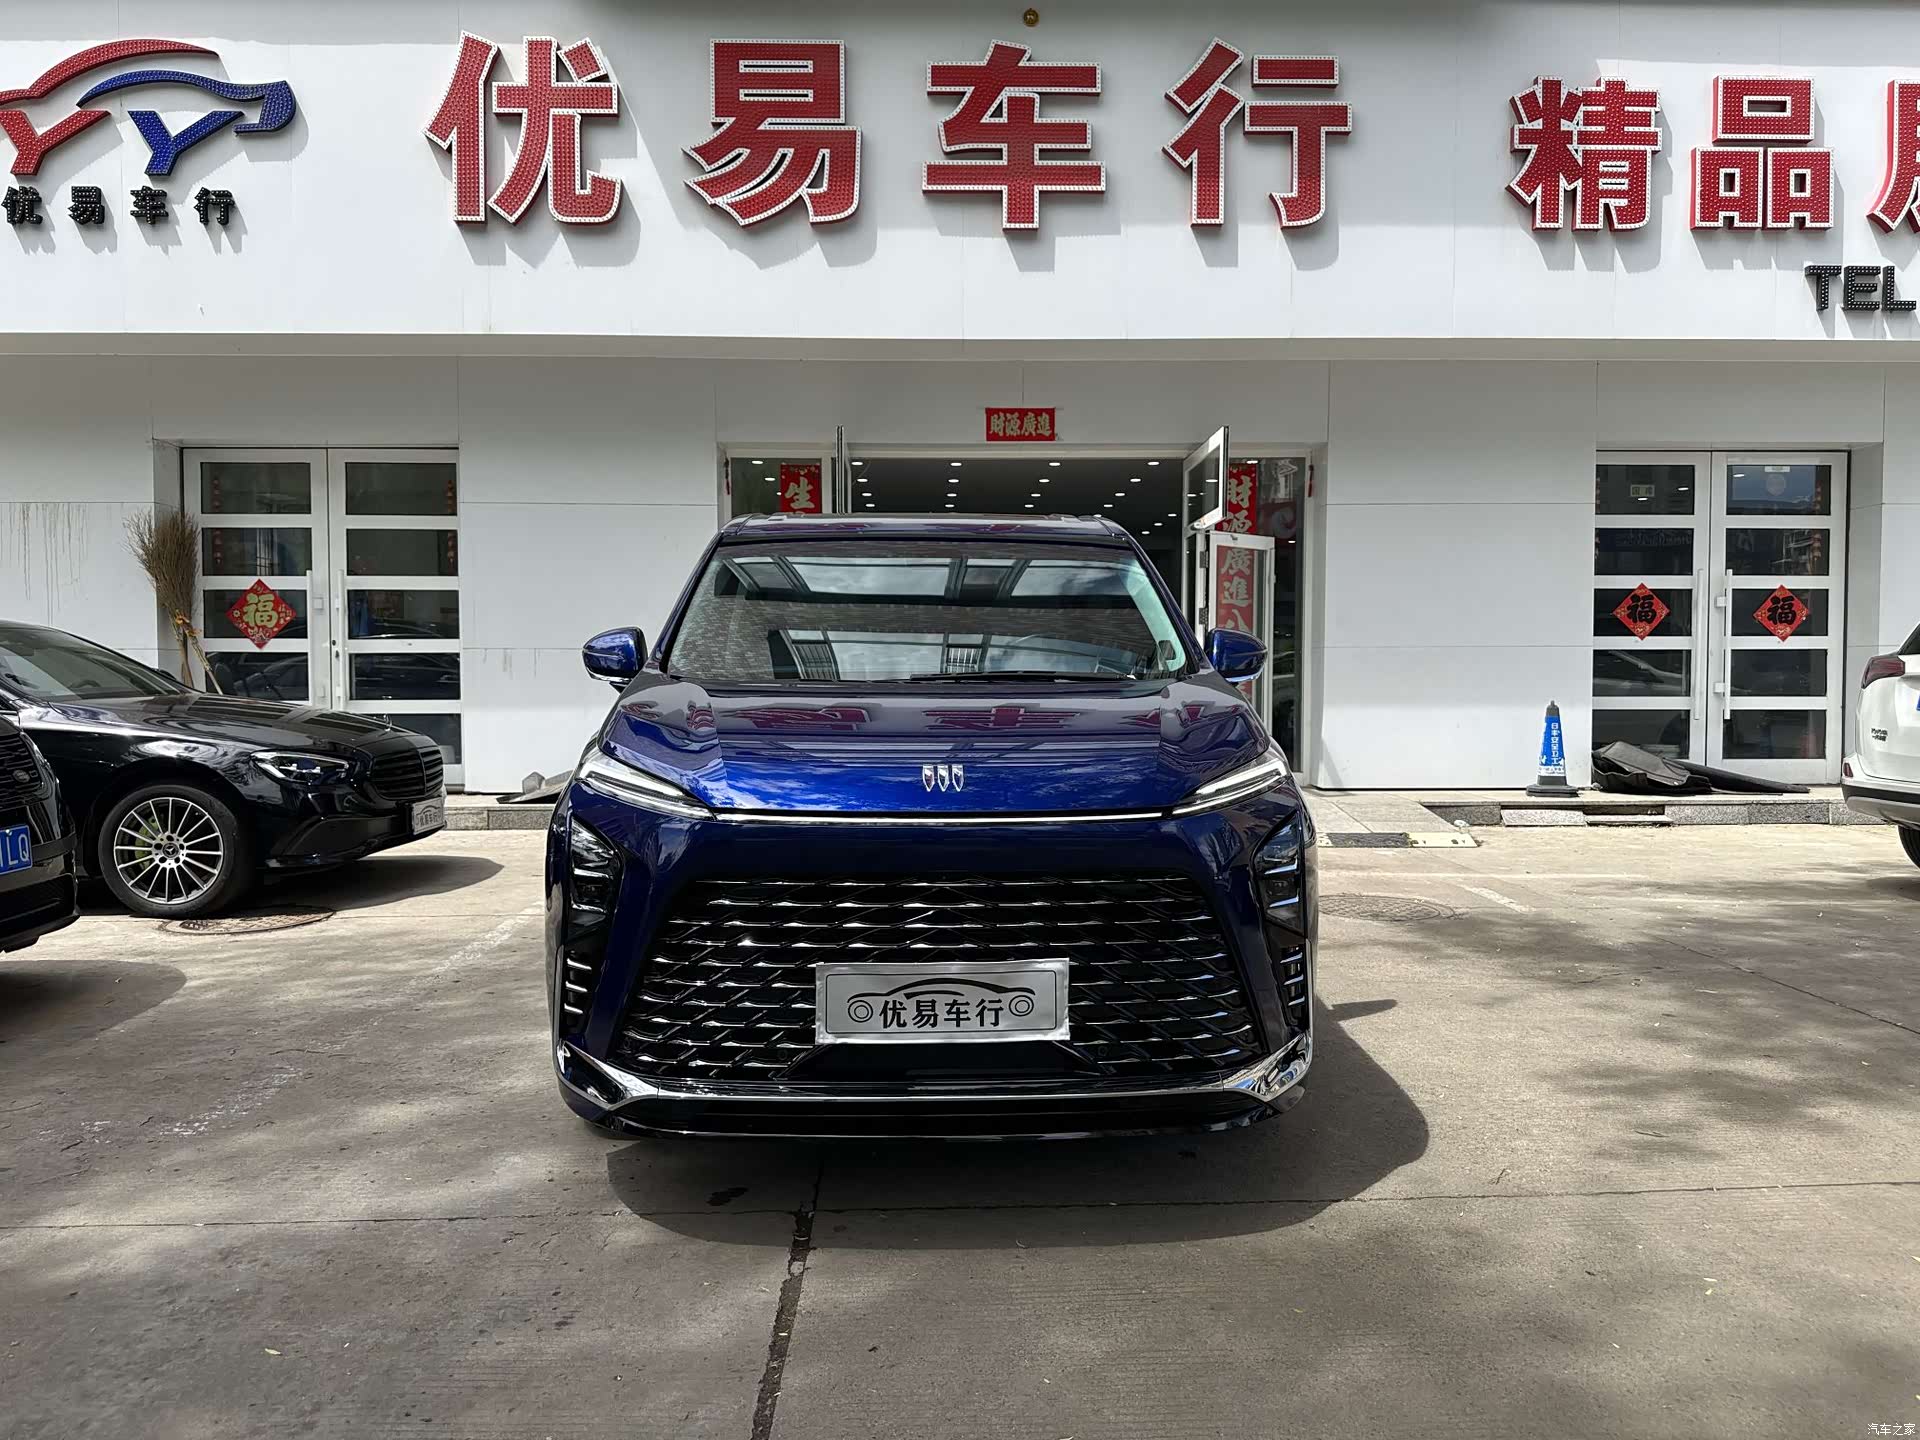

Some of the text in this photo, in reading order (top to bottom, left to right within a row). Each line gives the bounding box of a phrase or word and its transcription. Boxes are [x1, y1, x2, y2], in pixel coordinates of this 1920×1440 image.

[421, 30, 1352, 230] 优易车行
[2, 186, 235, 225] 优易车行
[1804, 265, 1917, 313] TEL
[784, 476, 815, 510] 生
[242, 593, 279, 628] 福
[1626, 594, 1657, 625] 福
[1766, 596, 1797, 626] 福
[879, 998, 1005, 1029] 优易车行
